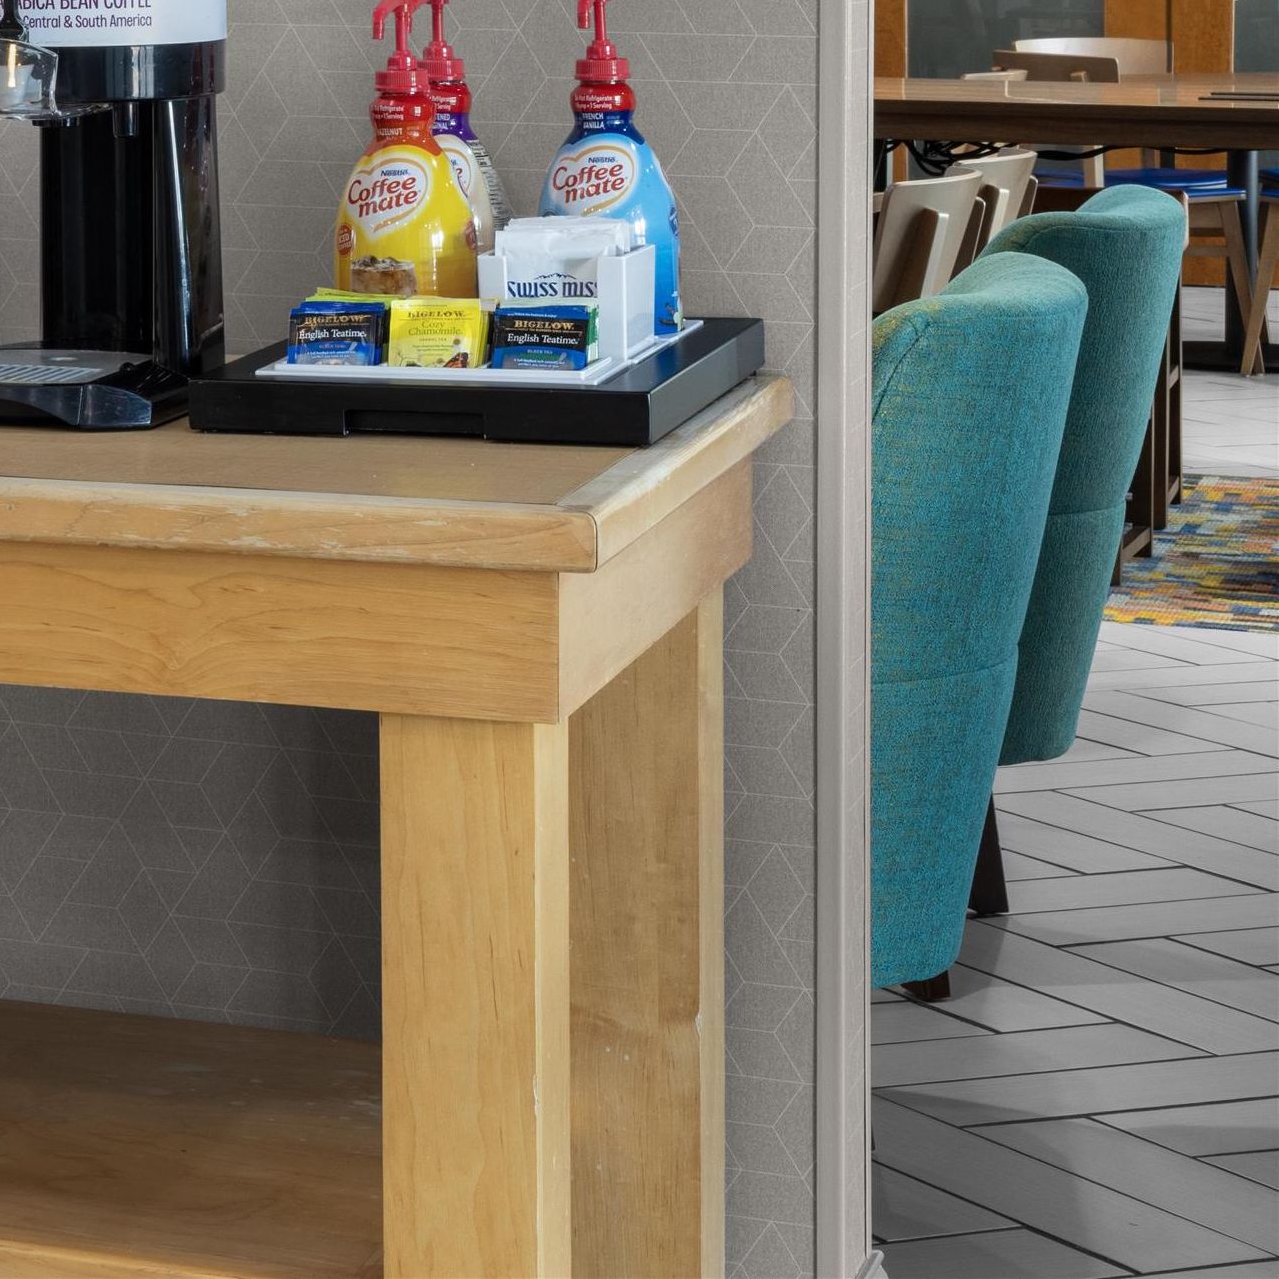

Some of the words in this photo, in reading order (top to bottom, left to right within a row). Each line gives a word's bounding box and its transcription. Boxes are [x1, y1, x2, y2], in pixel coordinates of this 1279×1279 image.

[63, 16, 72, 28] &
[75, 15, 107, 28] South
[109, 13, 153, 28] America
[552, 164, 624, 191] Coffee
[347, 176, 417, 205] Coffee
[564, 177, 625, 204] mate
[358, 190, 418, 218] mate
[299, 329, 330, 341] English
[421, 321, 445, 329] Cozy
[507, 333, 540, 345] English
